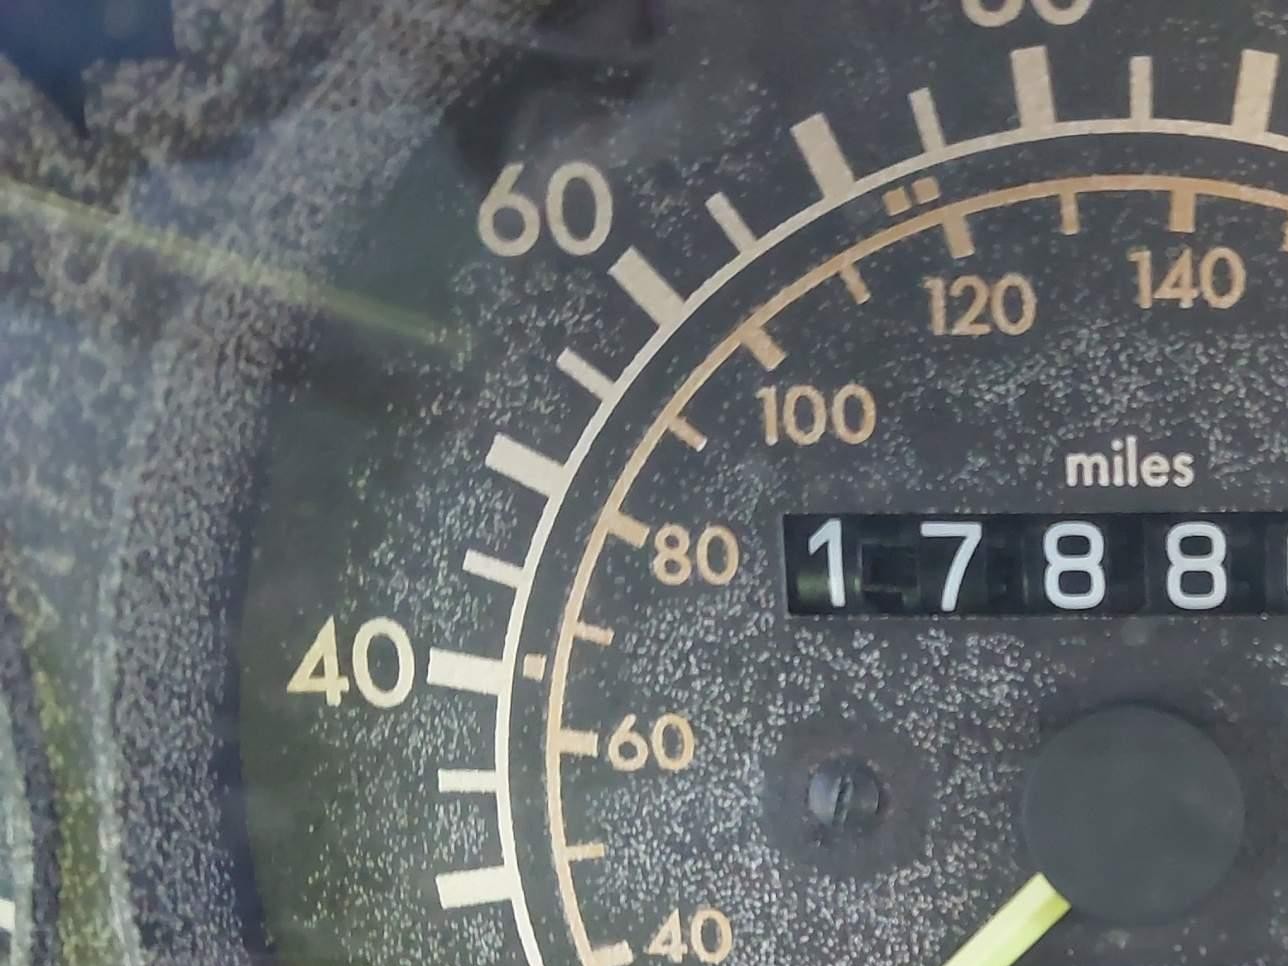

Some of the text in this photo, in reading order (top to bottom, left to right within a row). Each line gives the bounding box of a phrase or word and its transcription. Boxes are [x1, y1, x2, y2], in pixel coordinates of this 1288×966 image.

[477, 161, 613, 257] 60
[923, 275, 1037, 336] 120
[1127, 247, 1246, 310] 140
[755, 383, 876, 446] 100
[1065, 436, 1195, 488] miles
[651, 525, 740, 586] 80
[286, 616, 415, 707] 40
[607, 713, 696, 772] 60
[648, 909, 733, 964] 40
